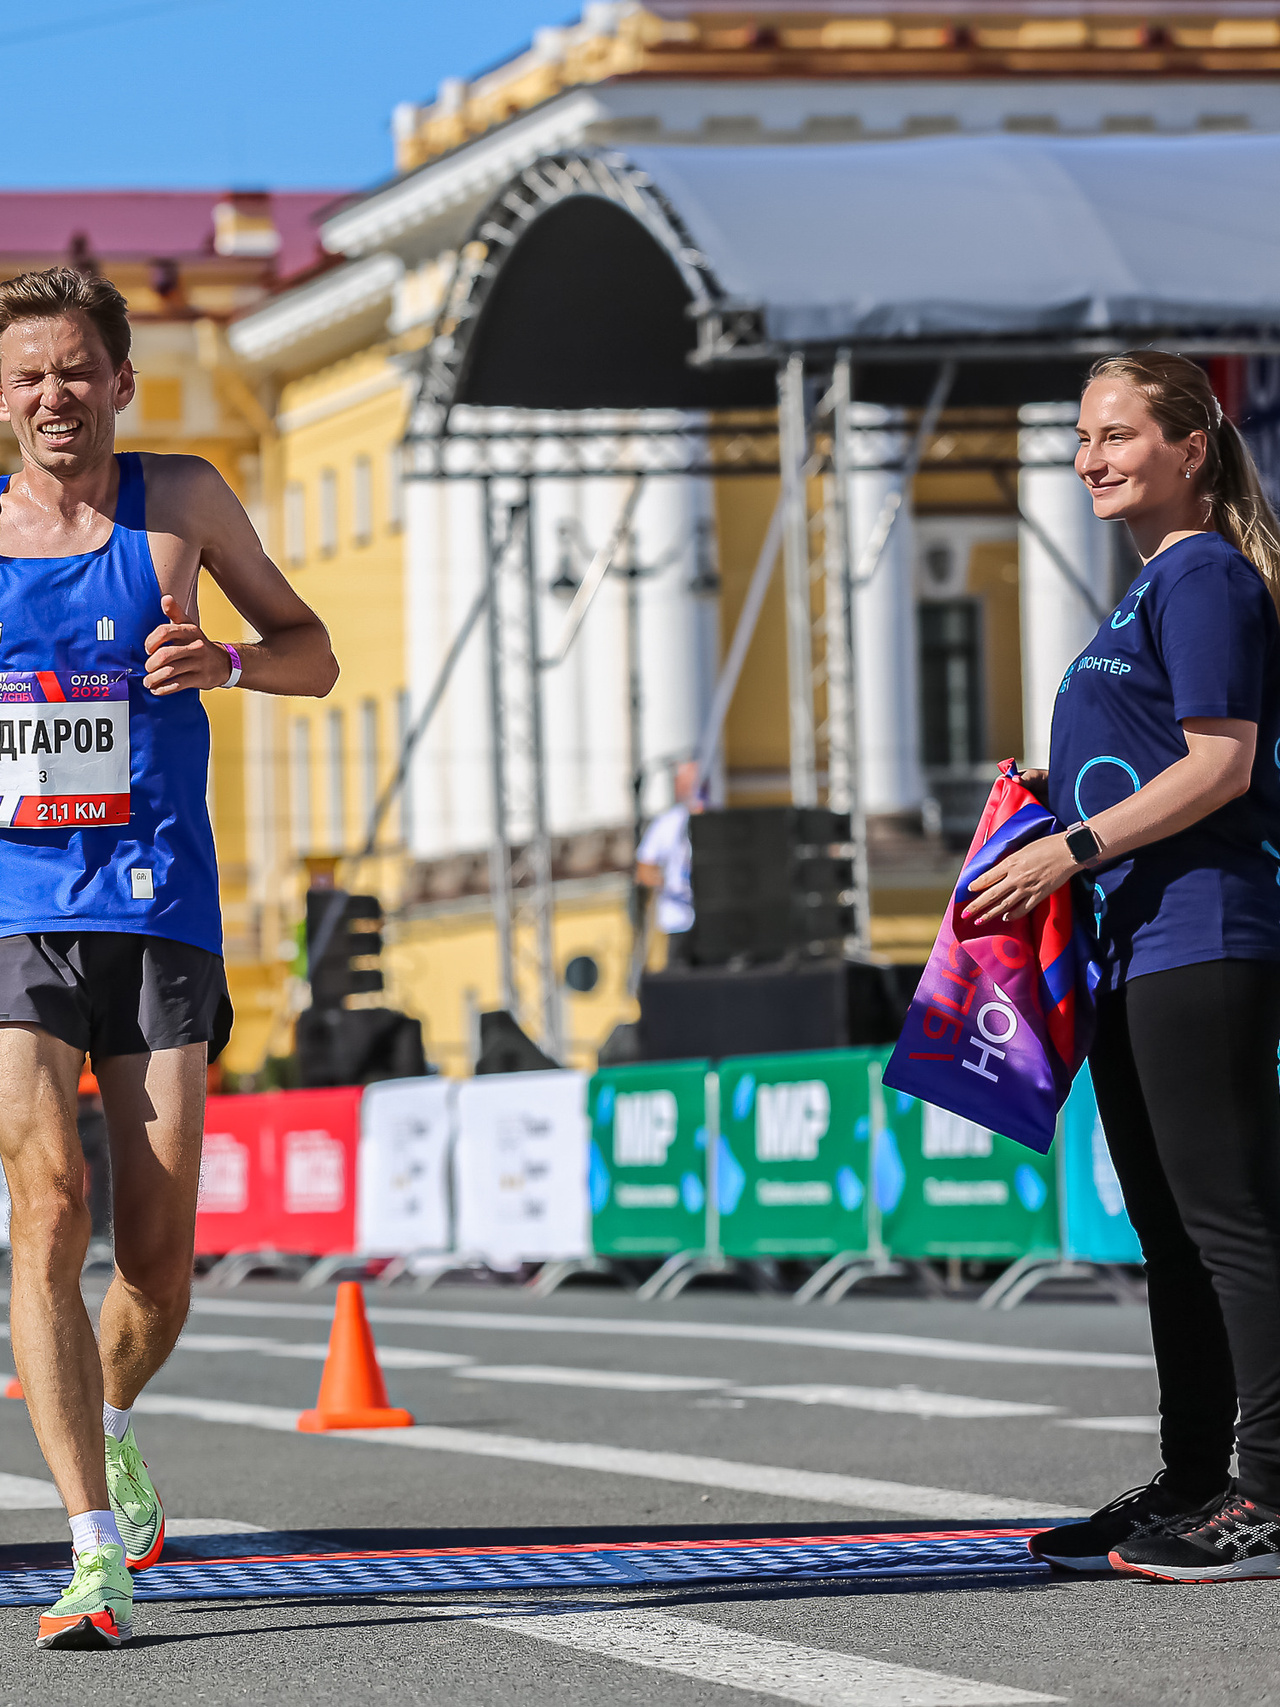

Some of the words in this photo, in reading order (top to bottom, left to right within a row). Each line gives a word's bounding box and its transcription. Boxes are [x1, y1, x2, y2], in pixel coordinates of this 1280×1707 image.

[71, 674, 109, 686] 07.08
[71, 686, 110, 698] 2022
[38, 770, 48, 784] 3
[36, 803, 69, 823] 21,1
